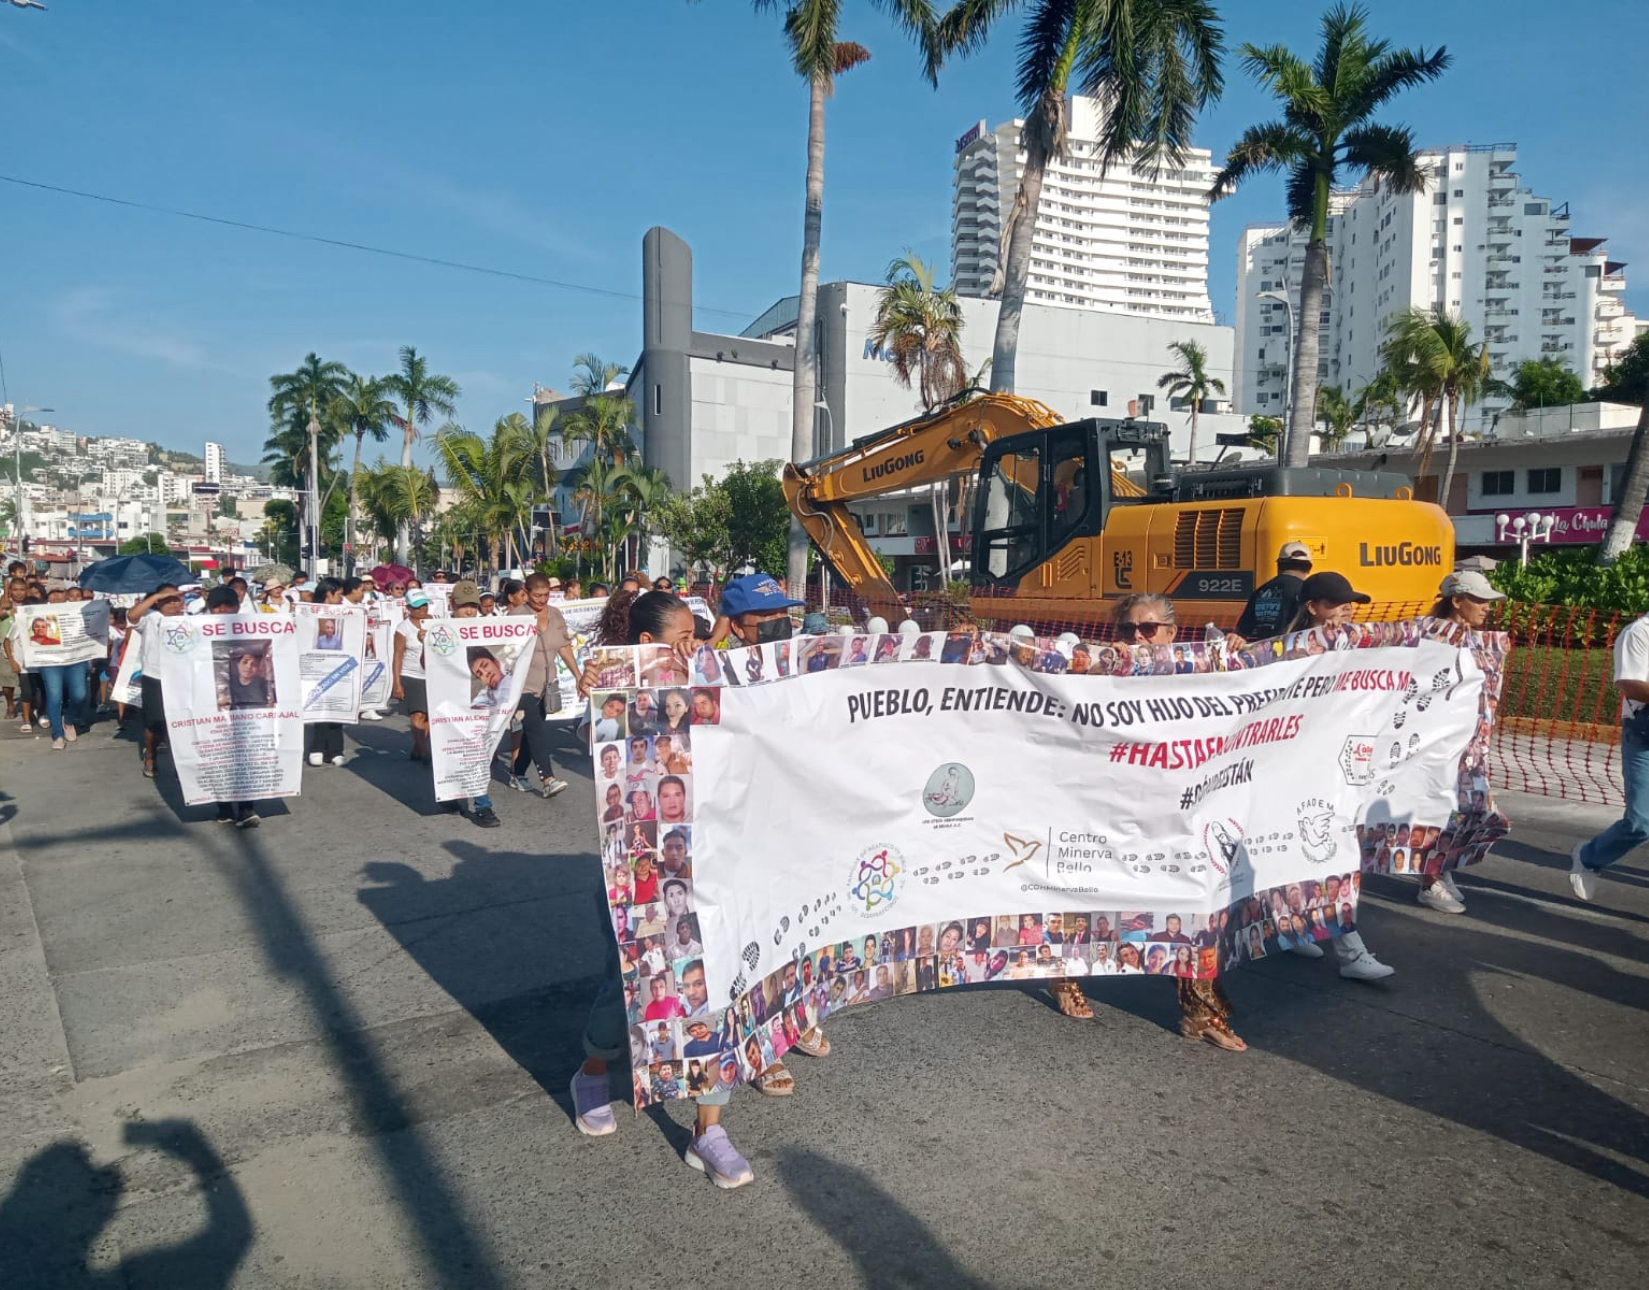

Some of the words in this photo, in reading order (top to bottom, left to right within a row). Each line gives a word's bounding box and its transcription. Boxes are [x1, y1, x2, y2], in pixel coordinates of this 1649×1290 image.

[1198, 579, 1242, 592] 922E
[202, 623, 227, 637] SE
[232, 621, 295, 635] BUSCA
[459, 627, 479, 640] SE
[482, 624, 539, 638] BUSCA
[848, 687, 934, 723] PUEBLO,
[940, 686, 1067, 719] ENTIENDE:
[1071, 703, 1104, 728] NO
[1106, 699, 1145, 727] SOY
[1145, 696, 1195, 722] HIJO
[1192, 695, 1233, 718] DEL
[1351, 670, 1395, 691] BUSCA
[213, 712, 253, 723] MAIANO
[255, 711, 300, 720] CARAJAL
[1059, 831, 1108, 845] Centro
[1058, 847, 1112, 859] Minerva
